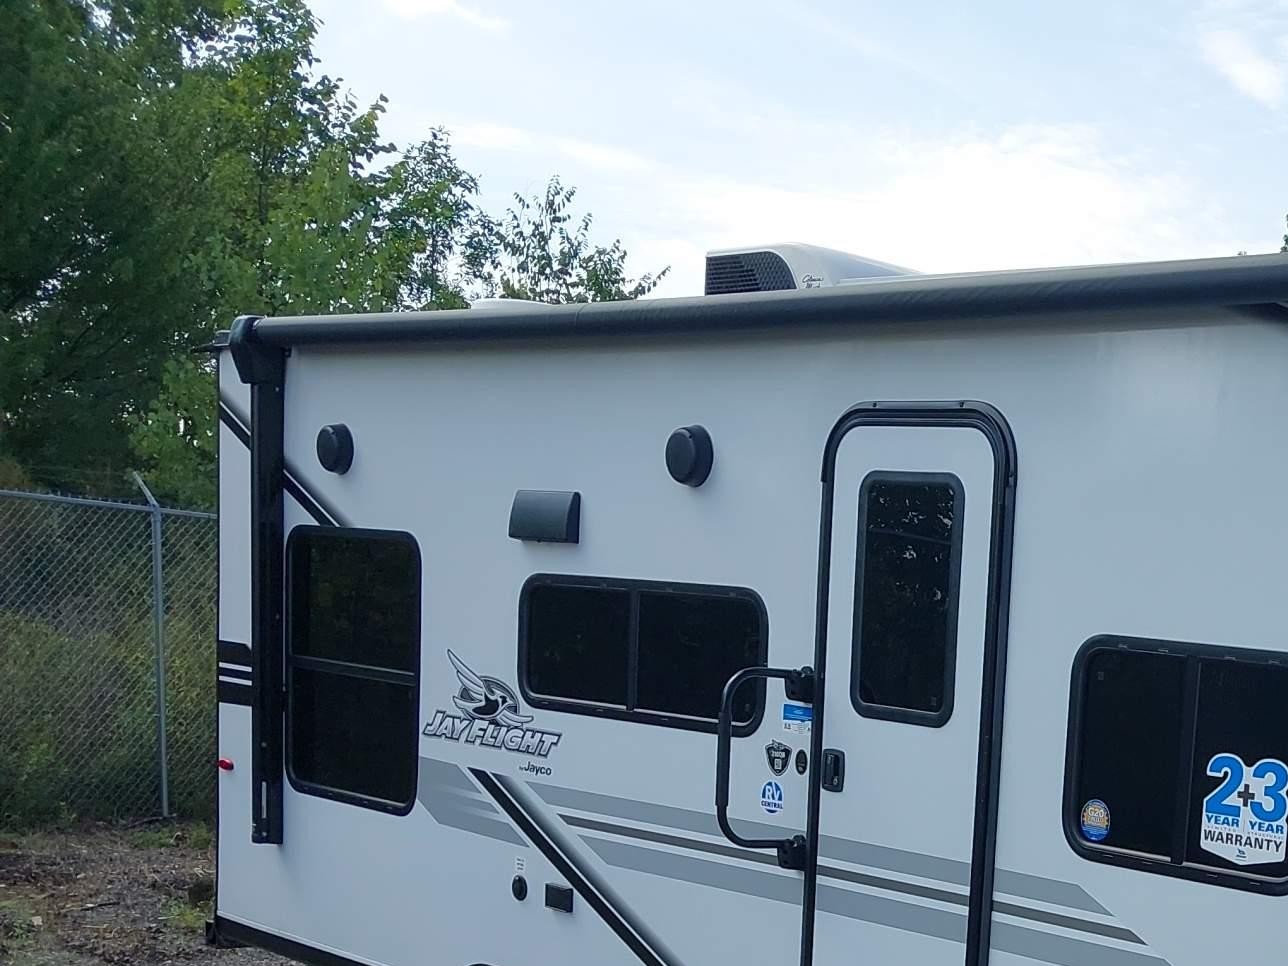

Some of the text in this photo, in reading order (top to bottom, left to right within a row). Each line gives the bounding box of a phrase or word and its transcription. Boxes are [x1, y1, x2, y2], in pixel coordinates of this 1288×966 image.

[423, 710, 562, 758] JAY FLIGHT
[524, 760, 552, 776] Jayco
[765, 782, 781, 801] RV
[761, 799, 784, 810] CENTRAL
[1088, 807, 1104, 818] G20
[1205, 814, 1284, 835] YEAR YEAR
[1203, 828, 1284, 853] WARRANTY
